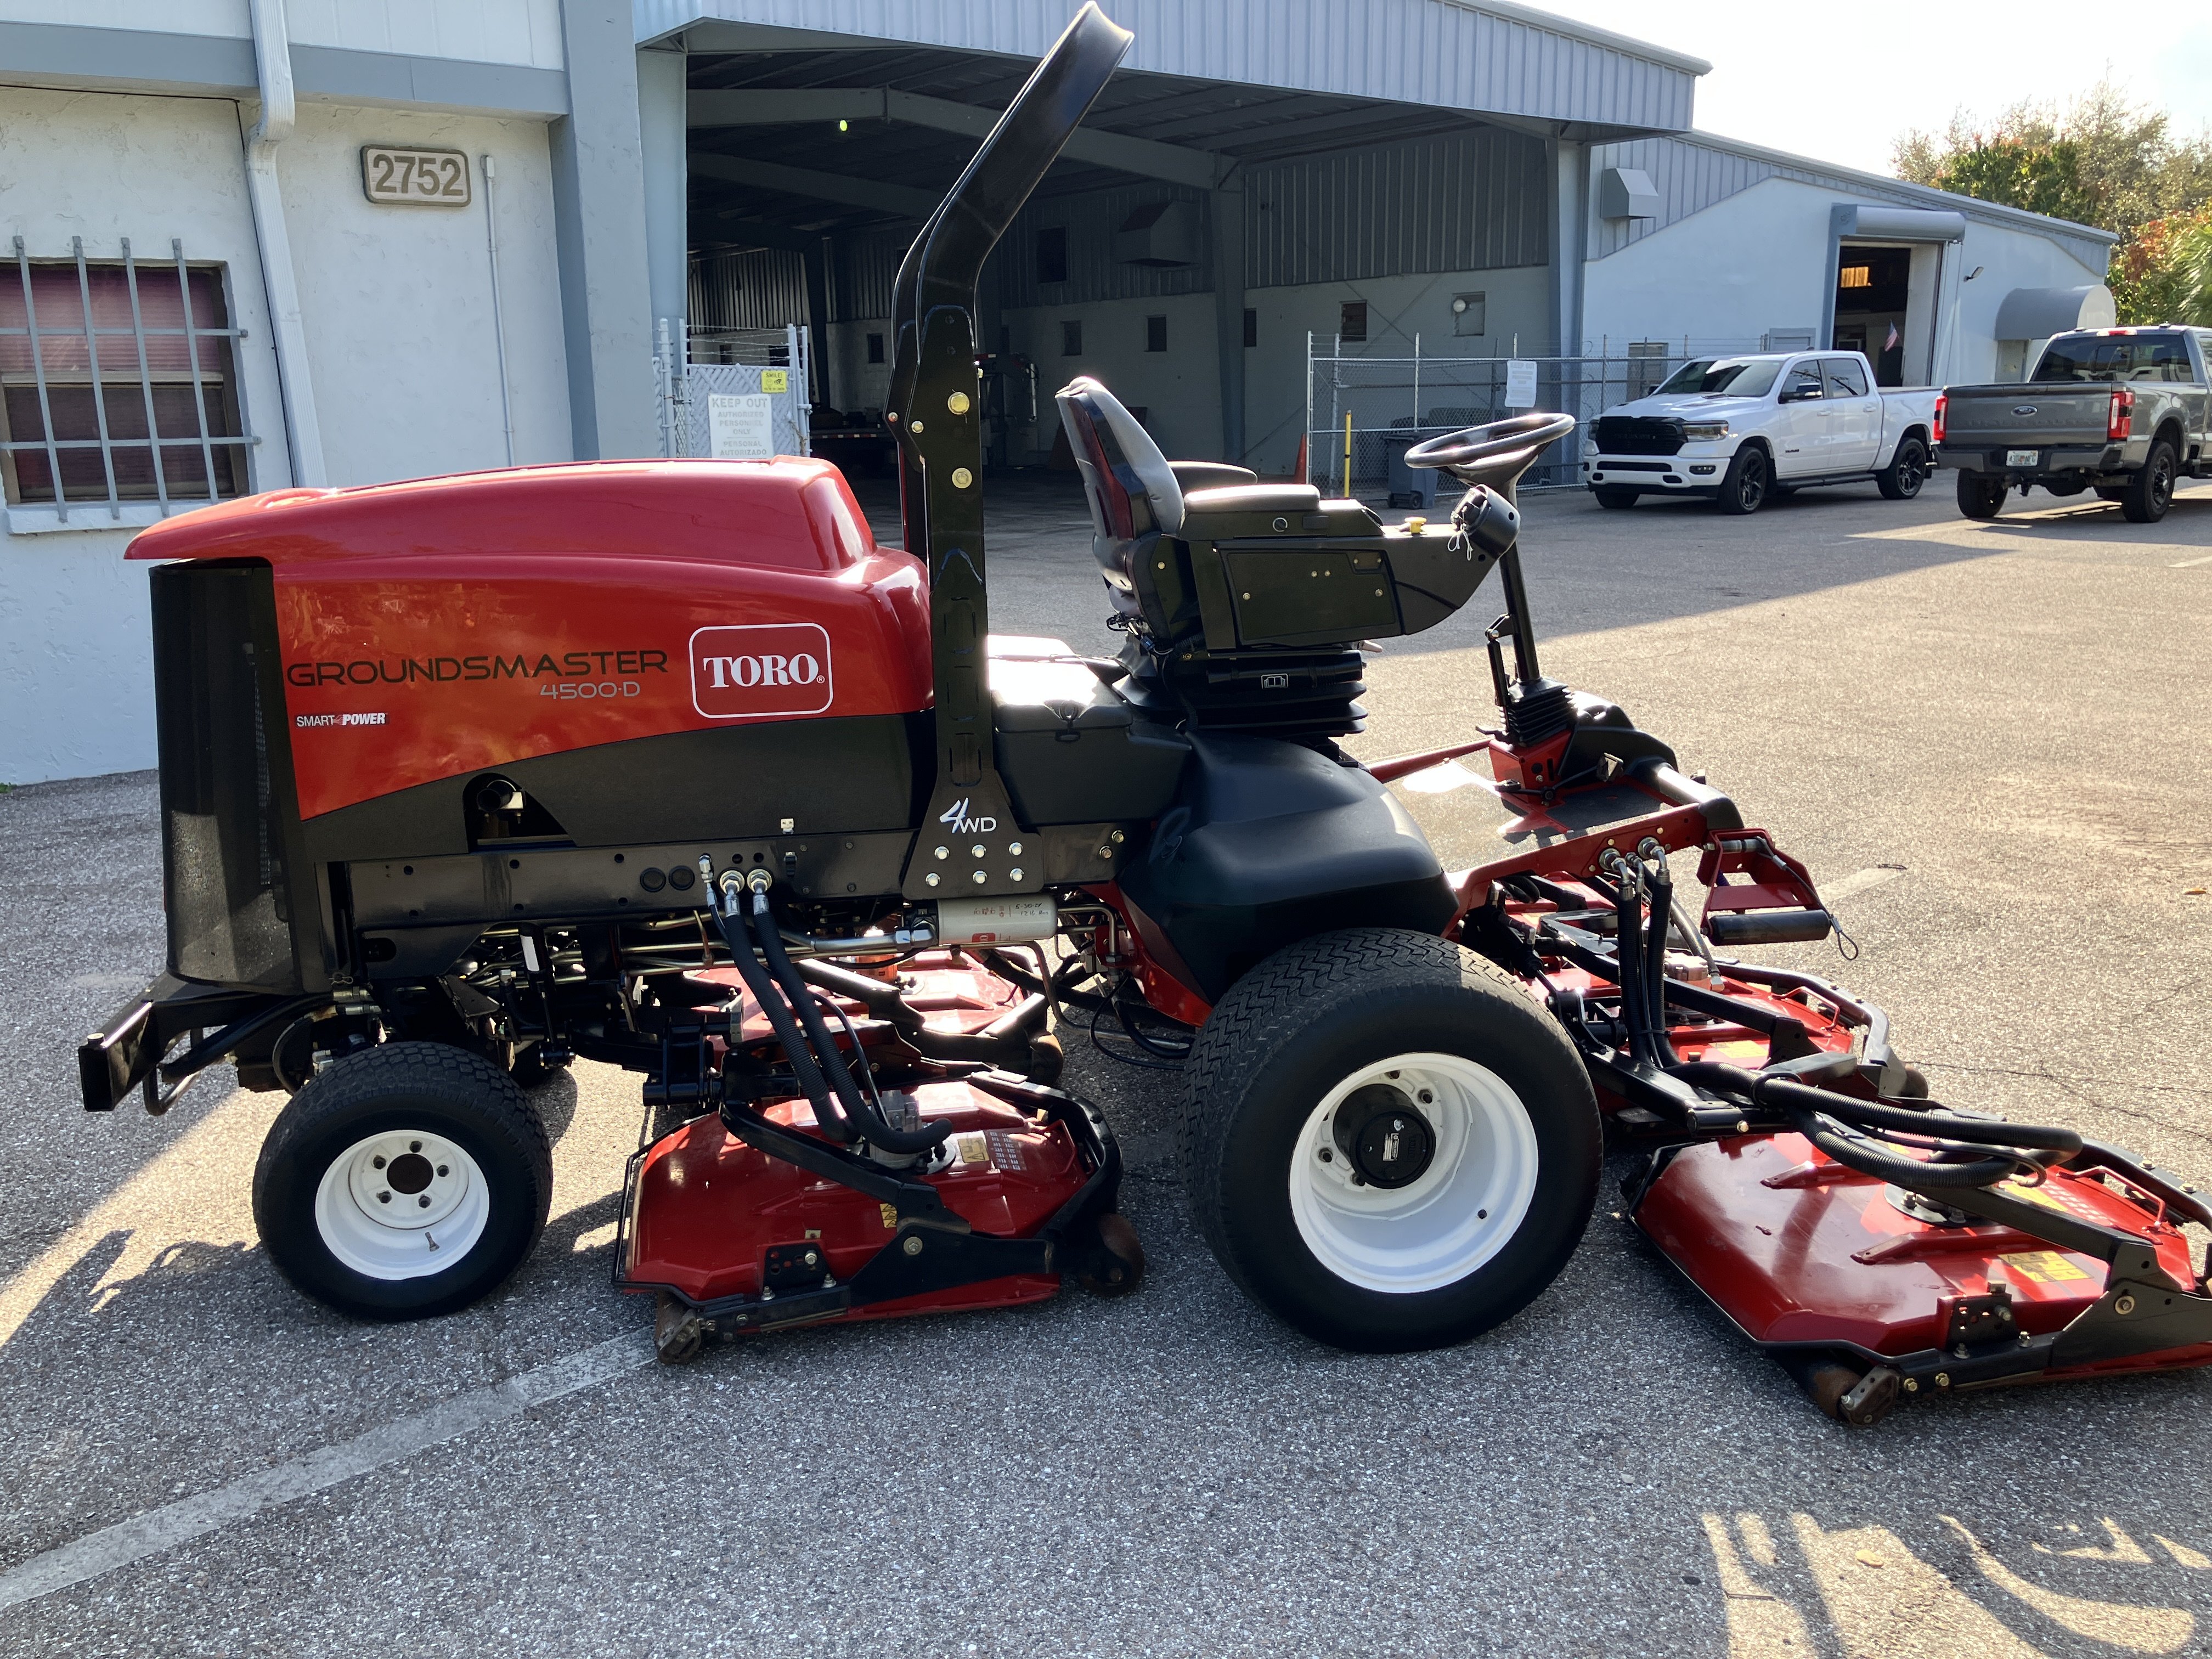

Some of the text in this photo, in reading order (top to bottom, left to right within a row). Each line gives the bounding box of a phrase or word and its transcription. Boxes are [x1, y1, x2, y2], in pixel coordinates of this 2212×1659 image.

[373, 154, 464, 196] 2752
[712, 398, 768, 408] KEEP OUT
[287, 650, 668, 686] GROUNDSMASTER
[703, 653, 819, 687] TORO
[297, 713, 386, 727] SMART POWER
[939, 797, 997, 834] 4WD
